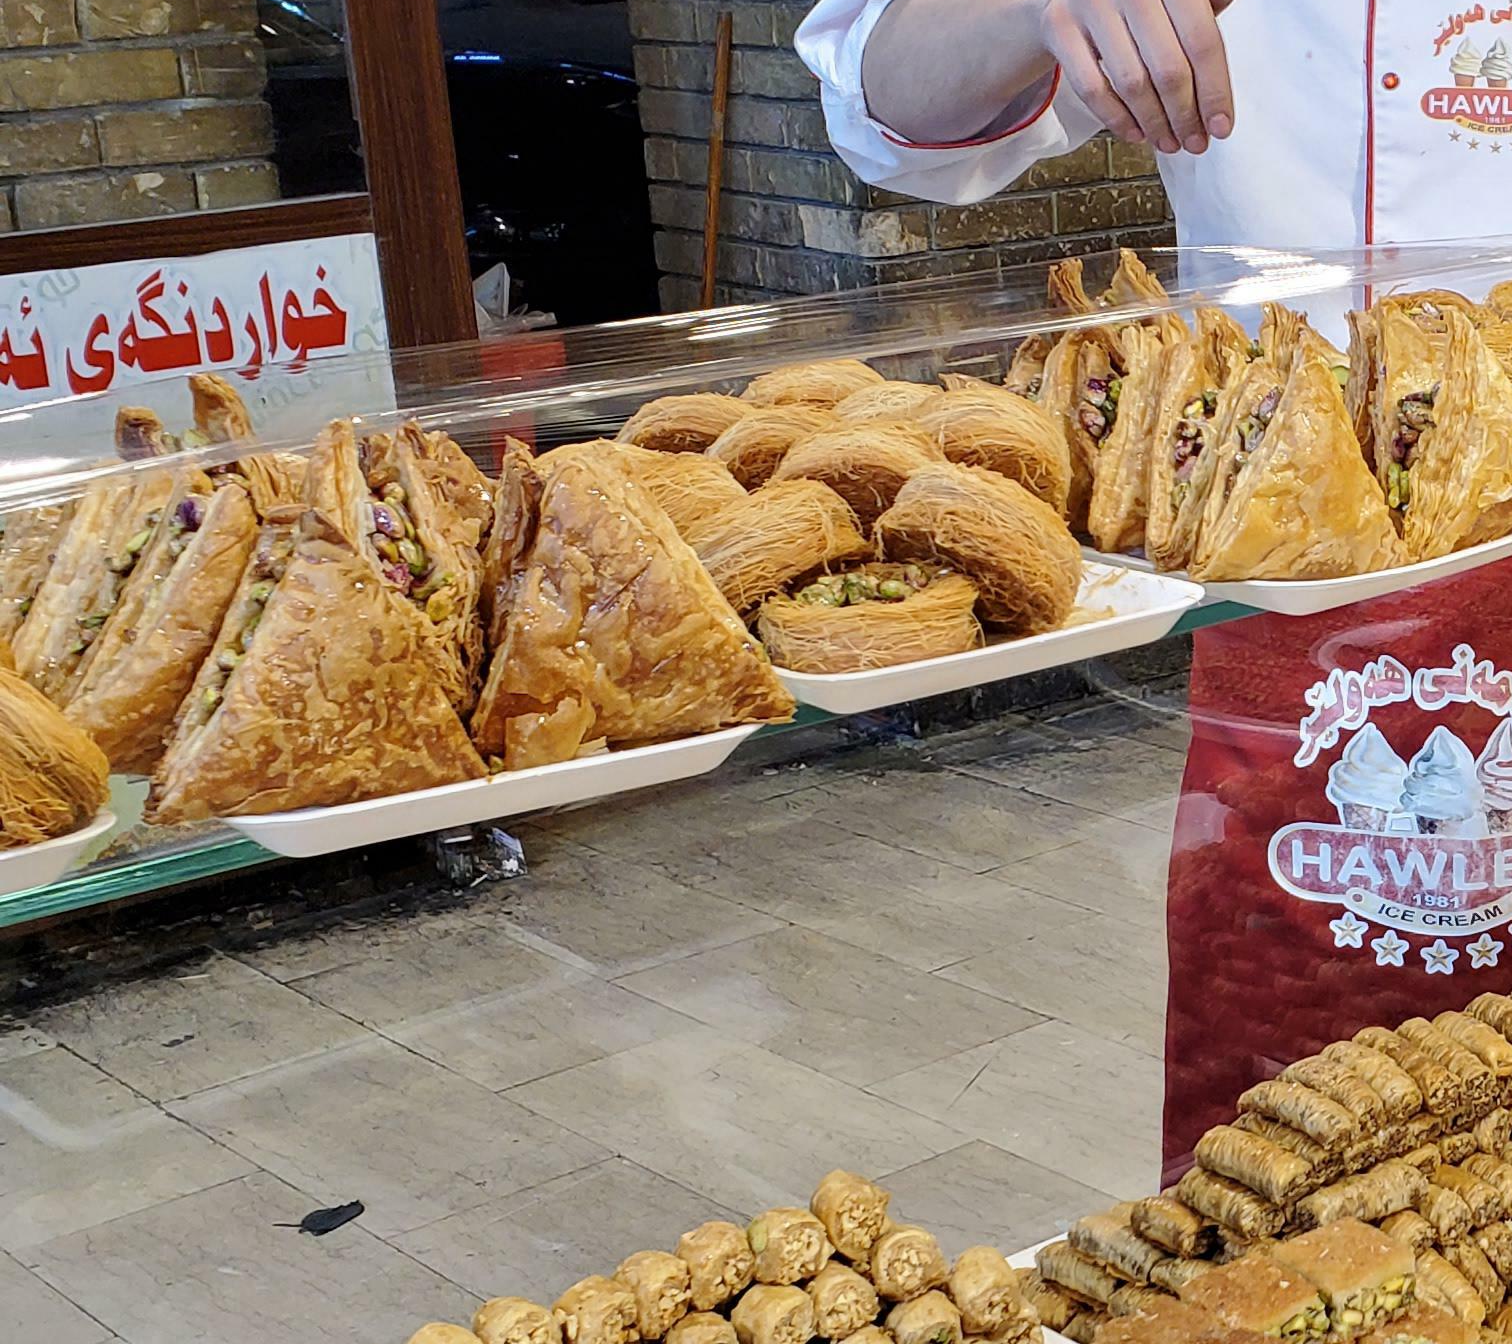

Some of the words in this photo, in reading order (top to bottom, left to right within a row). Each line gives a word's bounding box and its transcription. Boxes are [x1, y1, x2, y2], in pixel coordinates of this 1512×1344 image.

[1412, 892, 1461, 909] 1981
[1378, 902, 1417, 924] ICE
[1422, 903, 1504, 928] CREAM
